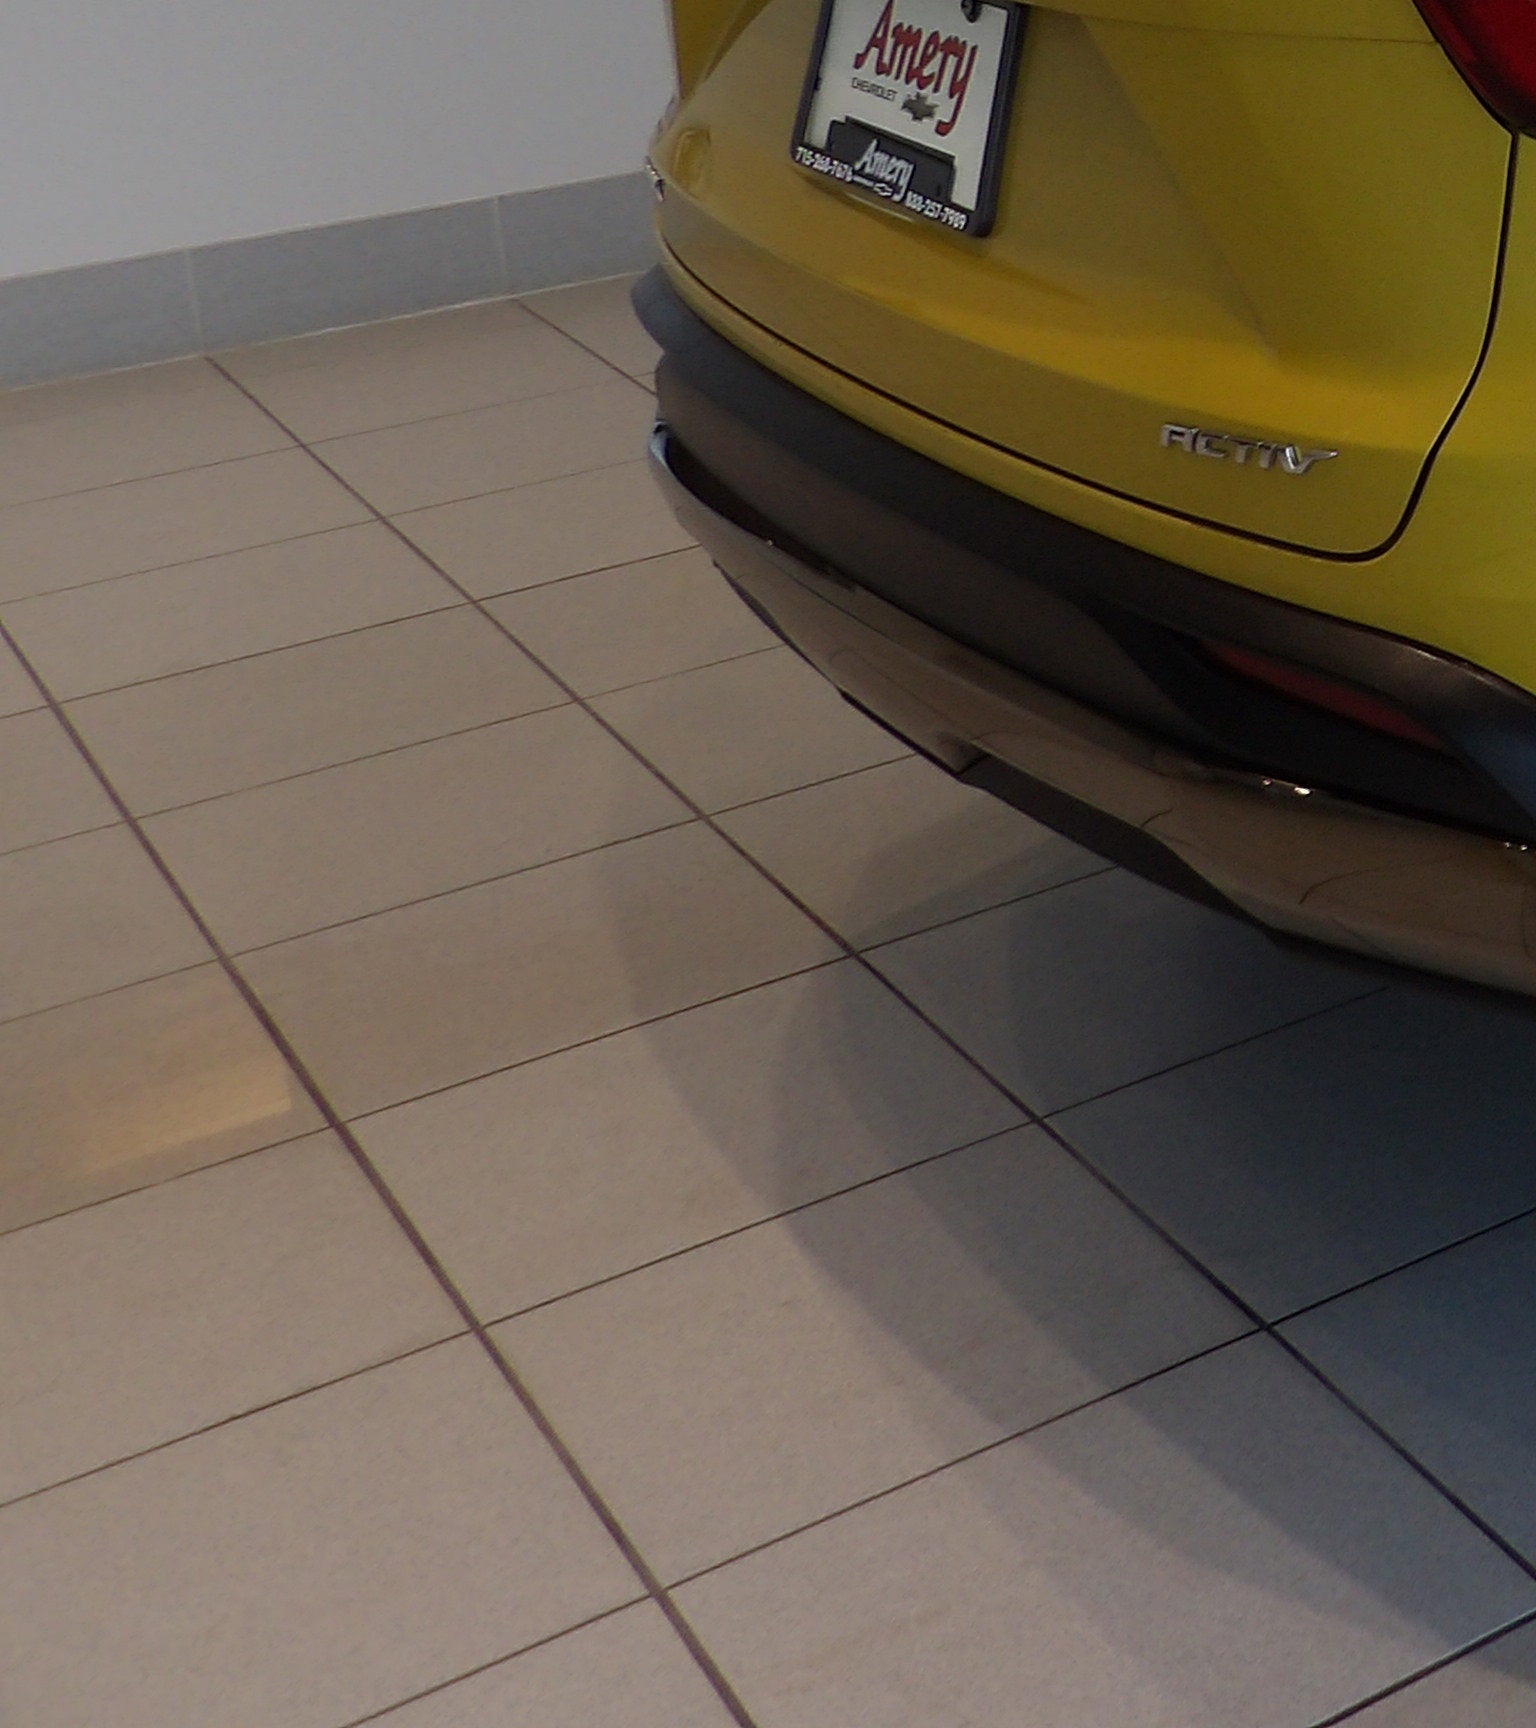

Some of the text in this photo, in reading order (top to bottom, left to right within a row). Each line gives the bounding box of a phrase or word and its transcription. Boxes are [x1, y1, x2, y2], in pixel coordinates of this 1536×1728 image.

[851, 76, 898, 103] CHEVROLET
[855, 138, 916, 201] Amery
[1160, 422, 1339, 474] ACTIV
